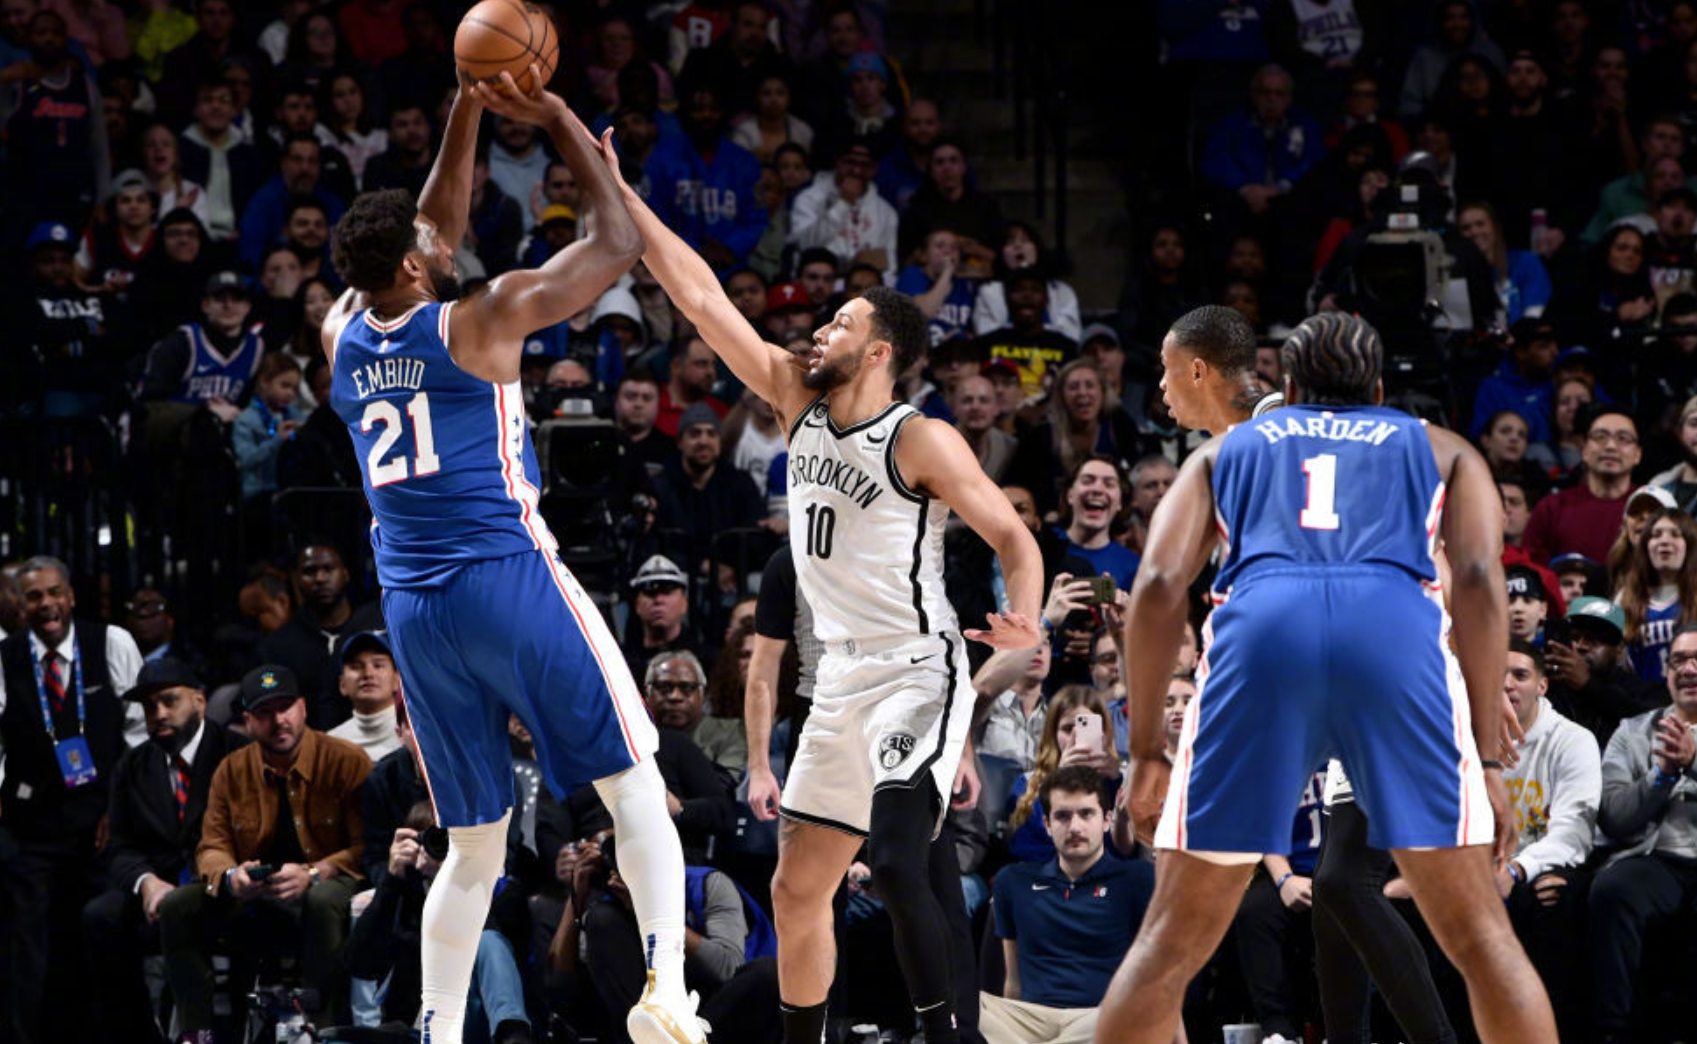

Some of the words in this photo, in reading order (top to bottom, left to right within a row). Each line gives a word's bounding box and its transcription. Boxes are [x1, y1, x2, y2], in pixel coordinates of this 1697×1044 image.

[352, 357, 426, 400] EMBIID
[360, 391, 441, 488] 21
[1254, 416, 1399, 446] HARDEN
[1299, 453, 1340, 530] 1
[806, 502, 836, 559] 10
